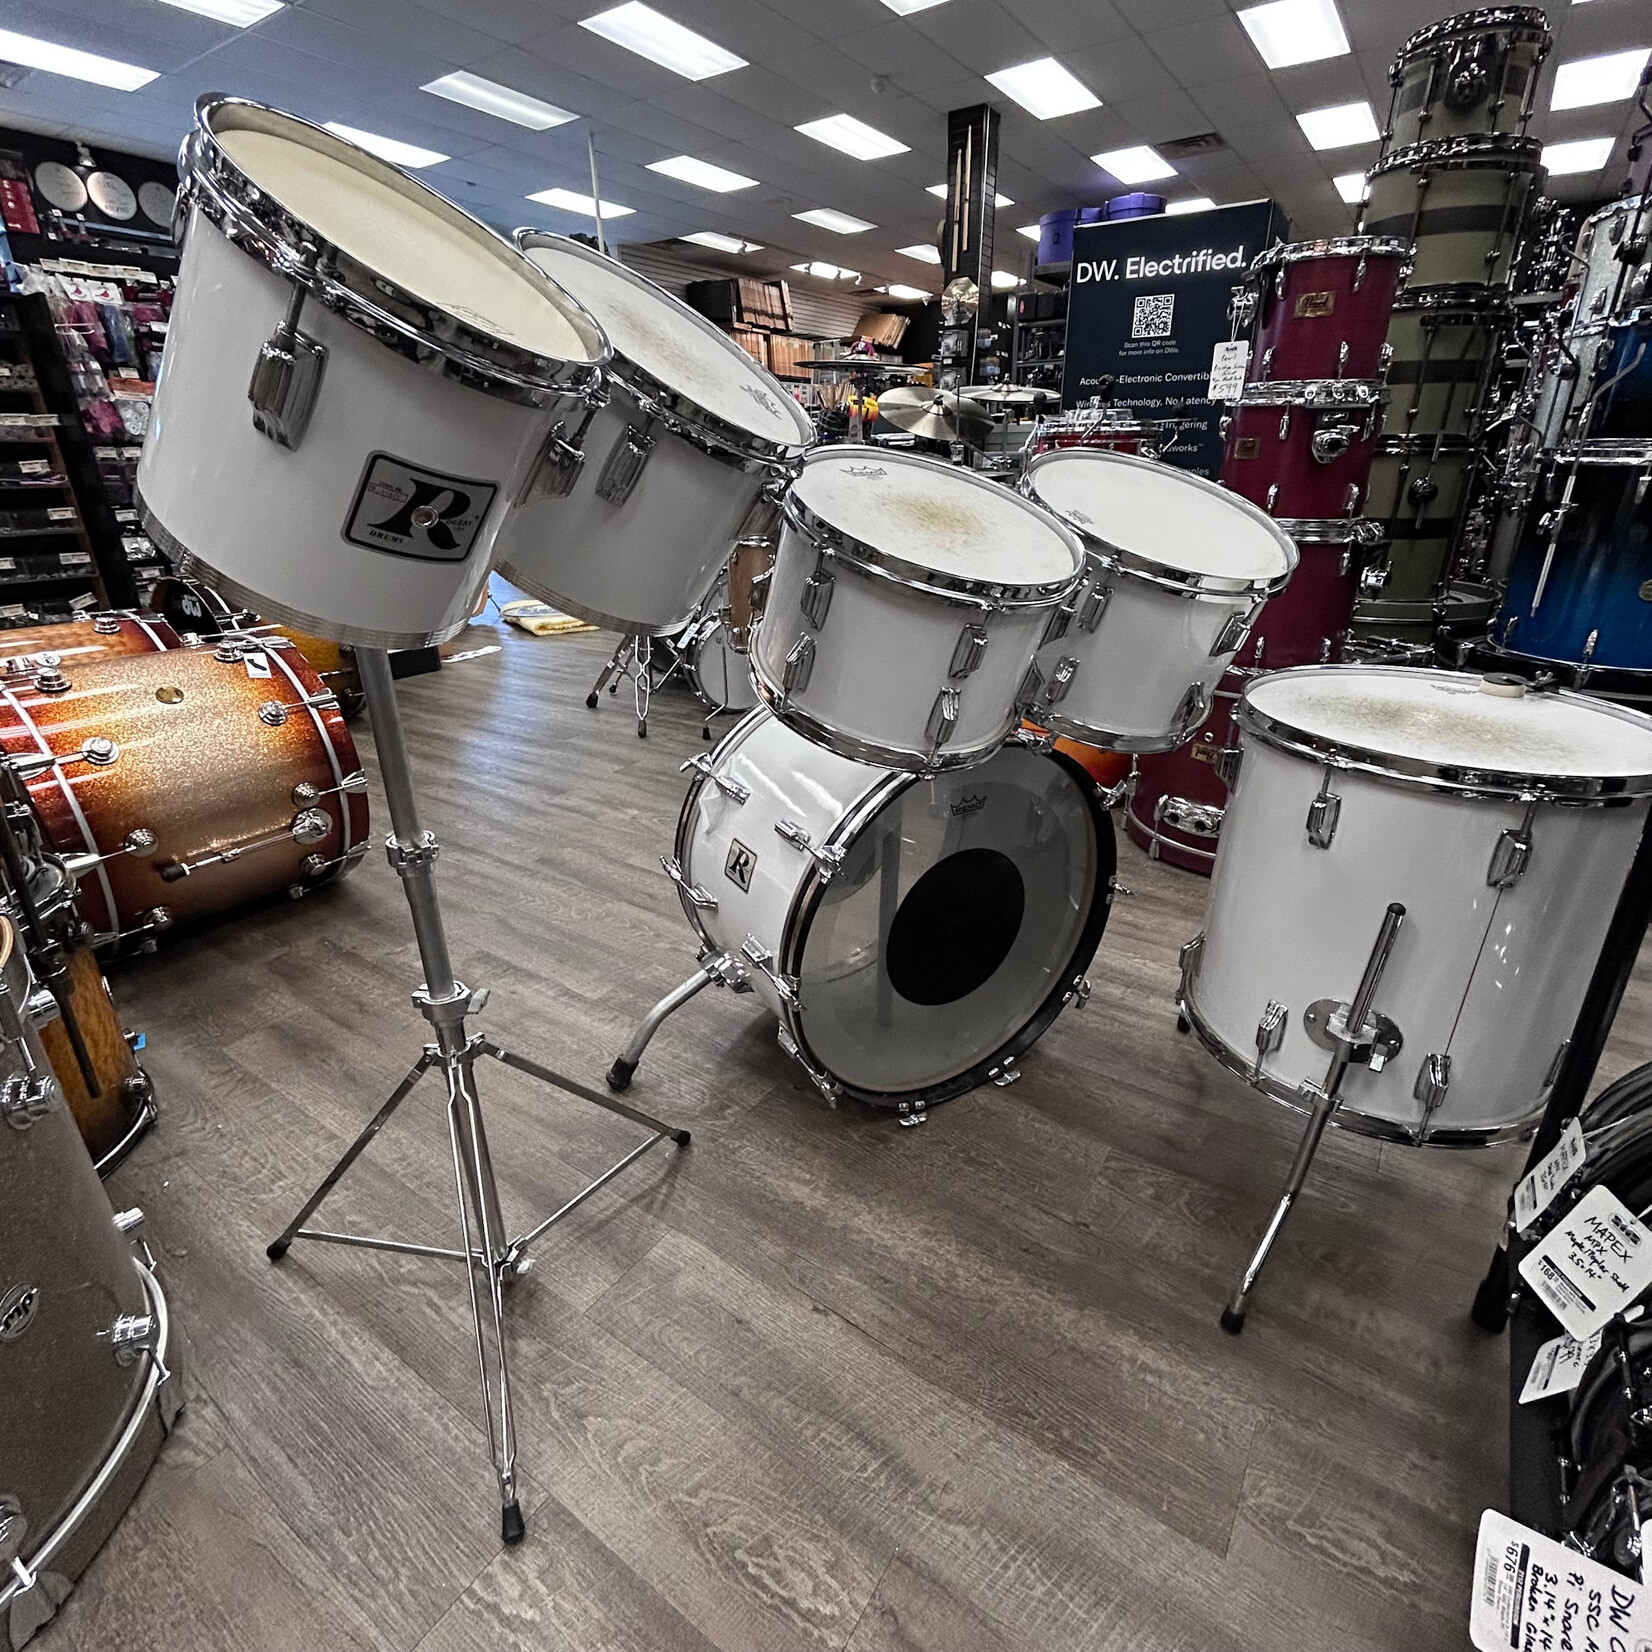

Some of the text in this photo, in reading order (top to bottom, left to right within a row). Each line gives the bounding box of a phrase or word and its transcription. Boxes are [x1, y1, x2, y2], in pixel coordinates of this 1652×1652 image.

[1076, 245, 1247, 283] DW. Electrified.
[1079, 374, 1163, 386] Acou-Electronic
[1164, 371, 1210, 382] Convertib
[1165, 396, 1179, 406] No
[369, 529, 405, 544] DRUMS
[1584, 1216, 1633, 1263] MAPEX
[1584, 1235, 1608, 1255] MPX
[1523, 1563, 1544, 1652] Broken Gla
[1560, 1598, 1580, 1651] Snare
[1586, 1589, 1602, 1632] SSC
[1609, 1584, 1635, 1633] DW
